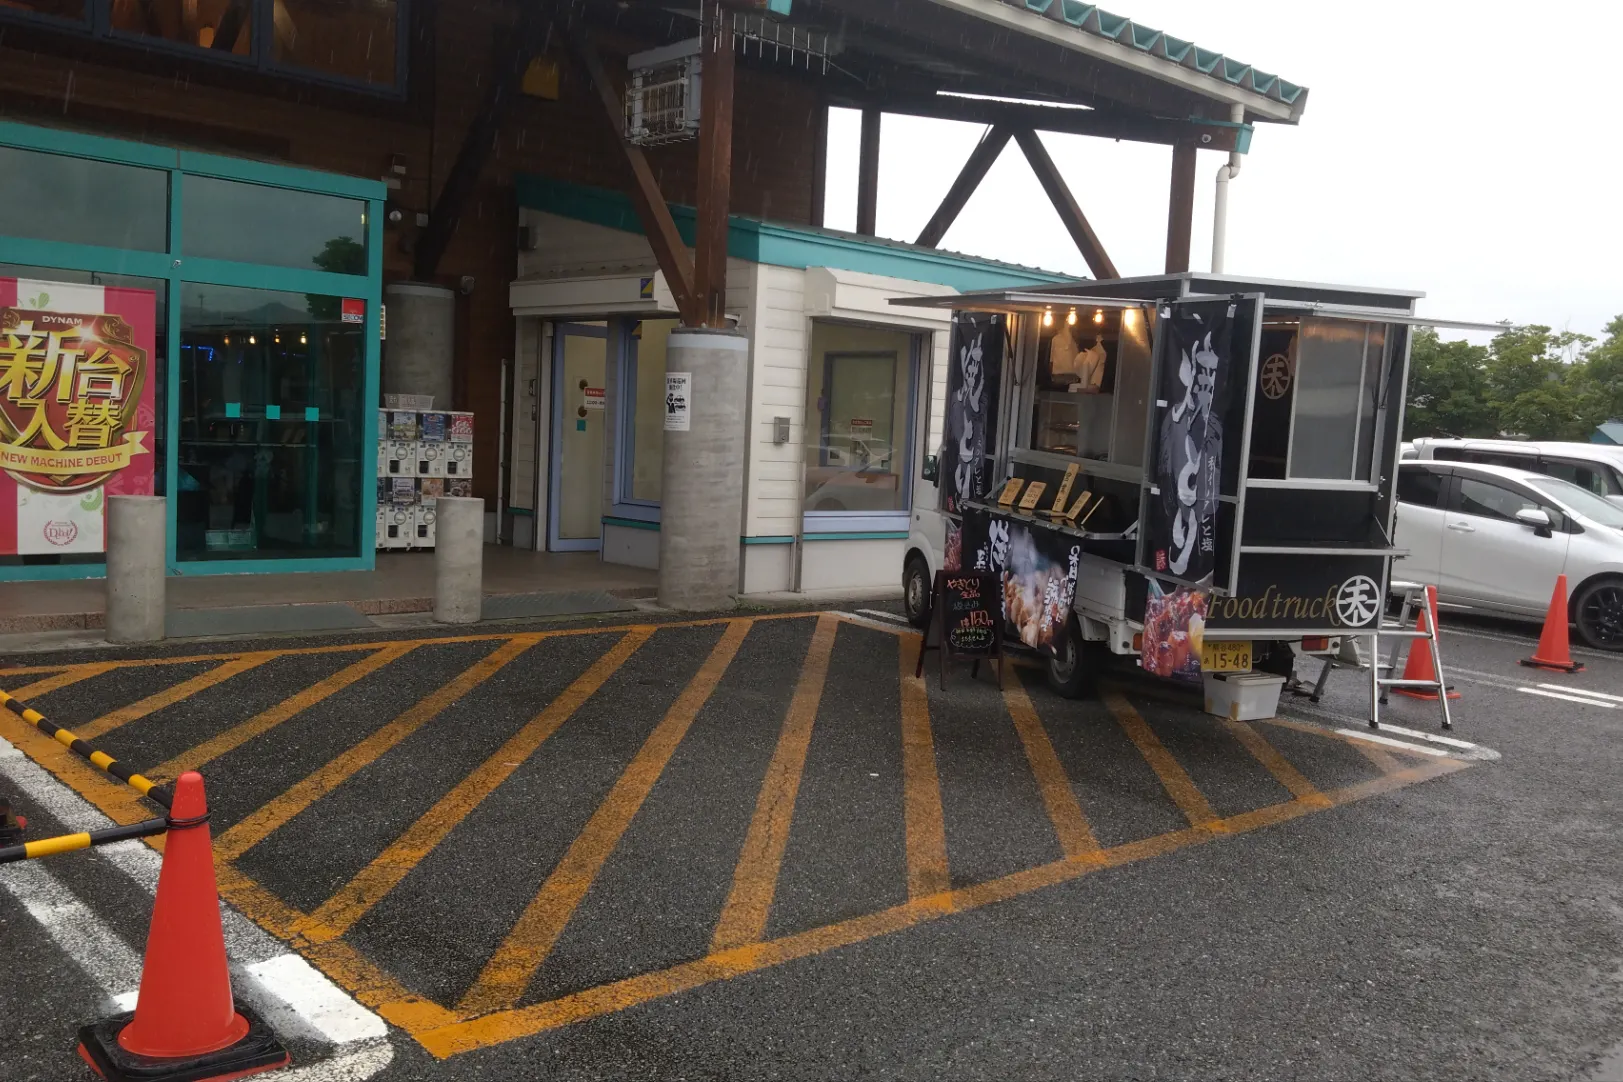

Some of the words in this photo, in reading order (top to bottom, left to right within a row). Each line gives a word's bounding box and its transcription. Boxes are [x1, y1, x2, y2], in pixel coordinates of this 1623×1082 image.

[42, 315, 82, 325] DYNAM
[0, 320, 132, 403] 新台
[11, 398, 123, 451] 入替
[0, 451, 28, 464] NEW
[30, 456, 83, 468] MACHINE
[86, 452, 123, 466] DEBUT
[947, 578, 980, 591] やきとり
[1206, 585, 1276, 619] Food
[1272, 585, 1341, 627] truck
[1213, 653, 1248, 669] 15-48
